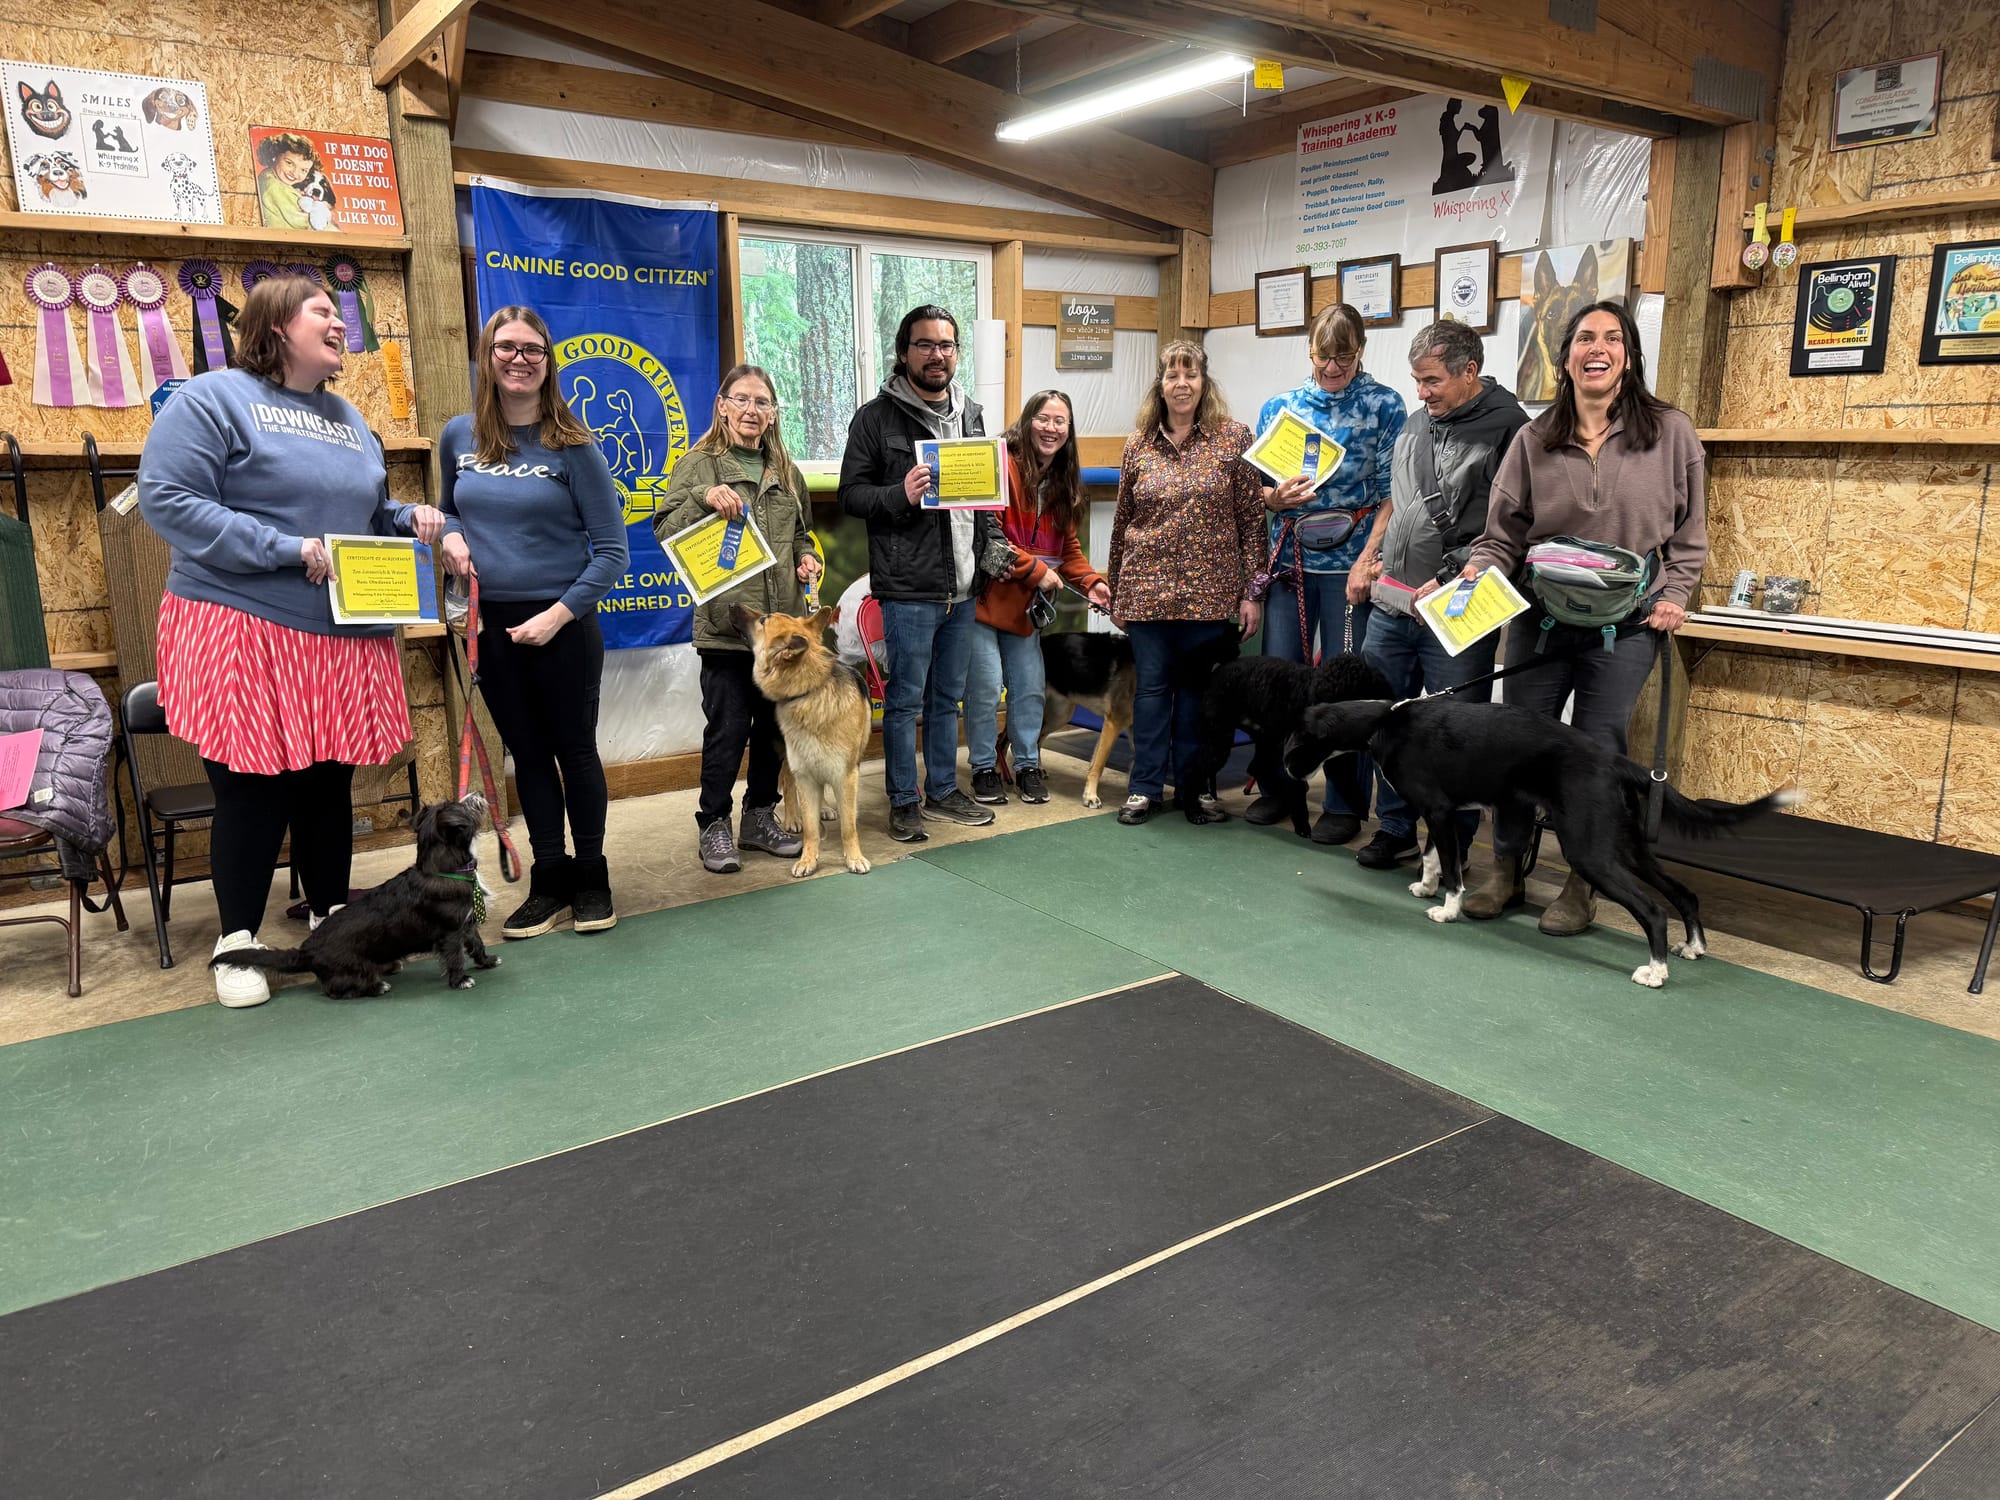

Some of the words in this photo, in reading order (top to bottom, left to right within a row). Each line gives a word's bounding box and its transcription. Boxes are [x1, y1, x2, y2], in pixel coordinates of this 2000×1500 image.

[82, 93, 131, 108] SMILES
[1302, 118, 1360, 139] Whispering
[1364, 113, 1372, 125] X
[1375, 108, 1396, 122] K-9
[1301, 136, 1343, 153] Training
[1346, 124, 1397, 144] Academy
[97, 152, 133, 163] Whispering
[324, 142, 338, 155] IF
[340, 143, 360, 157] MY
[363, 145, 388, 159] DOG
[99, 161, 112, 169] K-9
[114, 162, 139, 172] Training
[333, 158, 384, 173] DOESN'T
[1323, 153, 1369, 168] Reinforcement
[1369, 150, 1389, 160] Group
[331, 172, 363, 186] LIKE
[365, 175, 393, 191] YOU,
[1300, 178, 1311, 186] and
[1332, 169, 1359, 179] classes!
[1330, 182, 1366, 192] Obedience,
[343, 196, 349, 209] I
[351, 197, 386, 211] DON'T
[1331, 194, 1364, 204] Behavioral
[1365, 190, 1385, 199] Issues
[1303, 211, 1328, 221] Certified
[1330, 208, 1340, 217] AKC
[1342, 205, 1365, 214] Canine
[1366, 202, 1383, 211] Good
[1384, 199, 1405, 208] Citizen
[1434, 196, 1498, 222] Whispering
[1500, 190, 1511, 208] X
[337, 211, 369, 224] LIKE
[371, 213, 399, 226] YOU.
[1316, 223, 1330, 232] Trick
[1295, 238, 1347, 253] 360-393-7097
[485, 250, 565, 277] CANINE
[569, 261, 629, 281] GOOD
[1817, 271, 1872, 284] Bellingham
[1847, 278, 1871, 289] Alive!
[1068, 297, 1099, 326] dogs
[1808, 338, 1840, 346] READER'S
[1841, 336, 1868, 344] CHOICE
[1071, 353, 1086, 361] lives
[1087, 353, 1103, 361] whole
[563, 337, 633, 360] GOOD
[638, 356, 686, 451] CITIZEN
[256, 403, 355, 442] DOWNEAST
[263, 423, 280, 433] THE
[280, 425, 324, 441] UNFILTERED
[324, 434, 345, 447] CRAFT
[596, 594, 673, 613] NNERED
